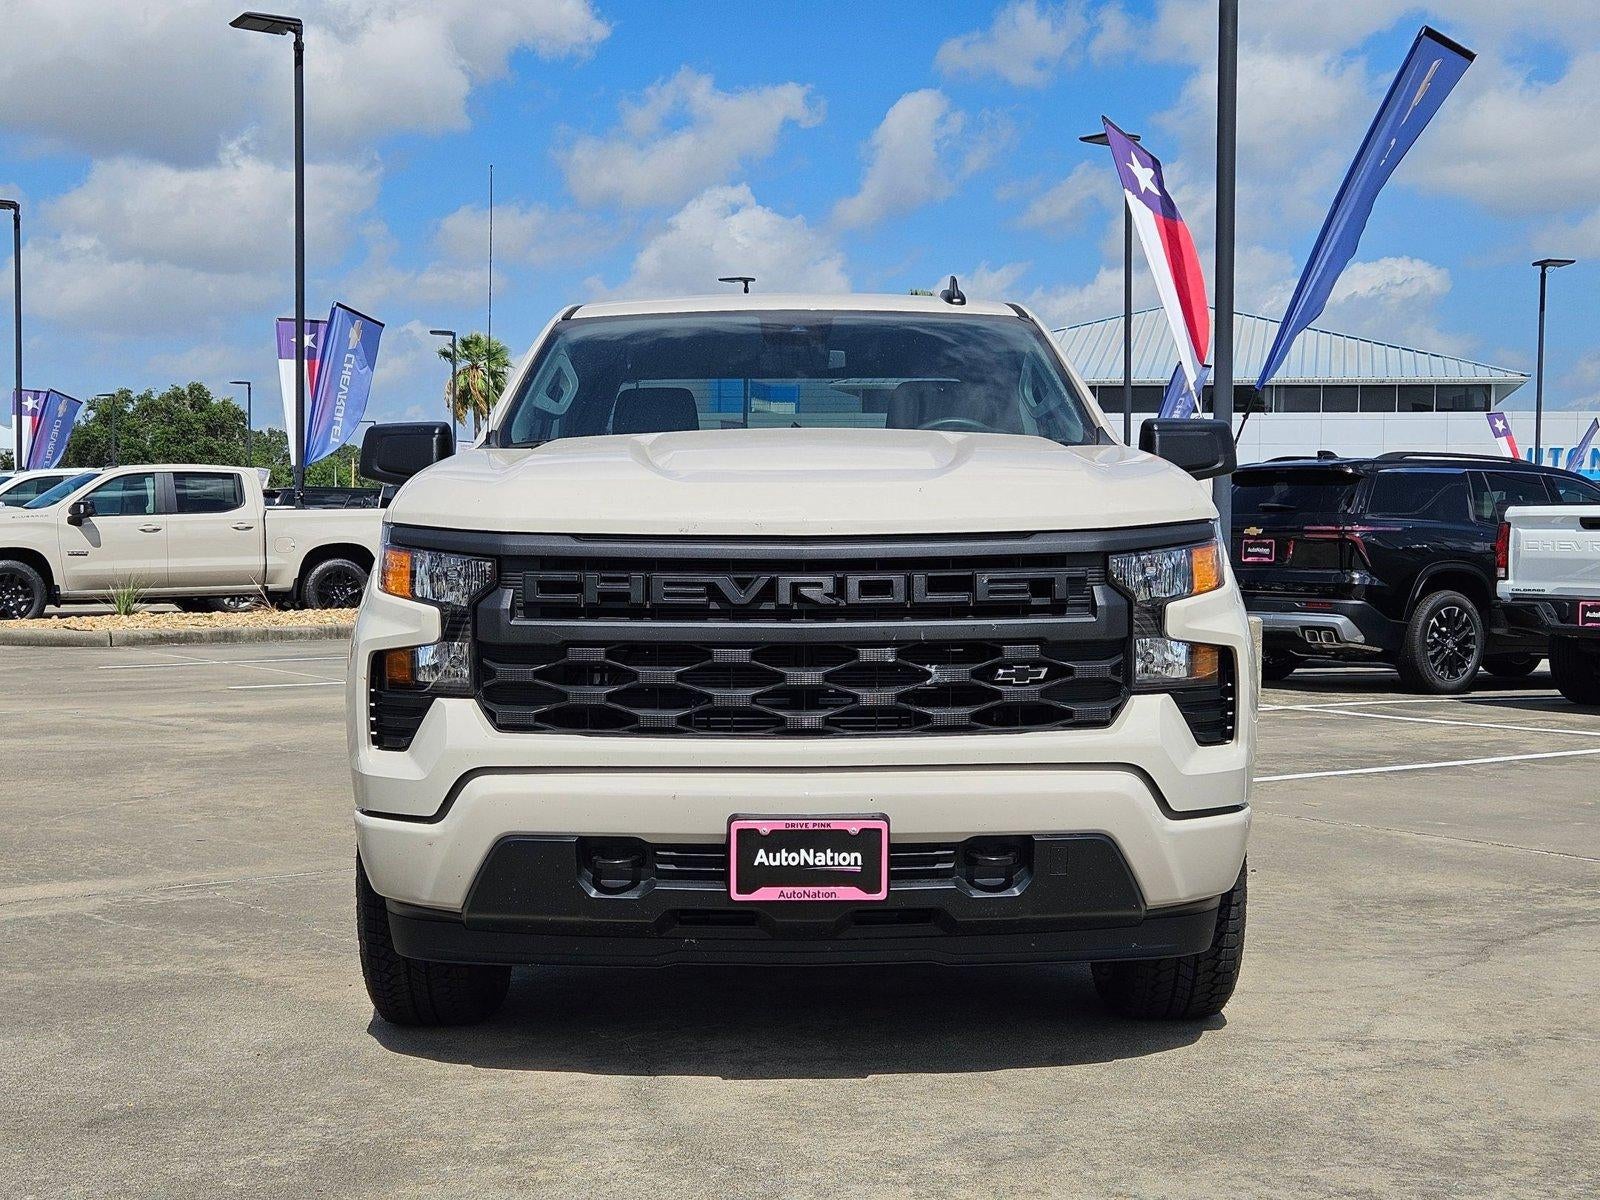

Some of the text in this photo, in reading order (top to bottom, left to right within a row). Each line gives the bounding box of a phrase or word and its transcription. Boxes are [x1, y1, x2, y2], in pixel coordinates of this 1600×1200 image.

[523, 571, 1087, 605] CHEVROLET
[754, 848, 862, 866] AutoNation
[778, 890, 837, 899] AutoNation
